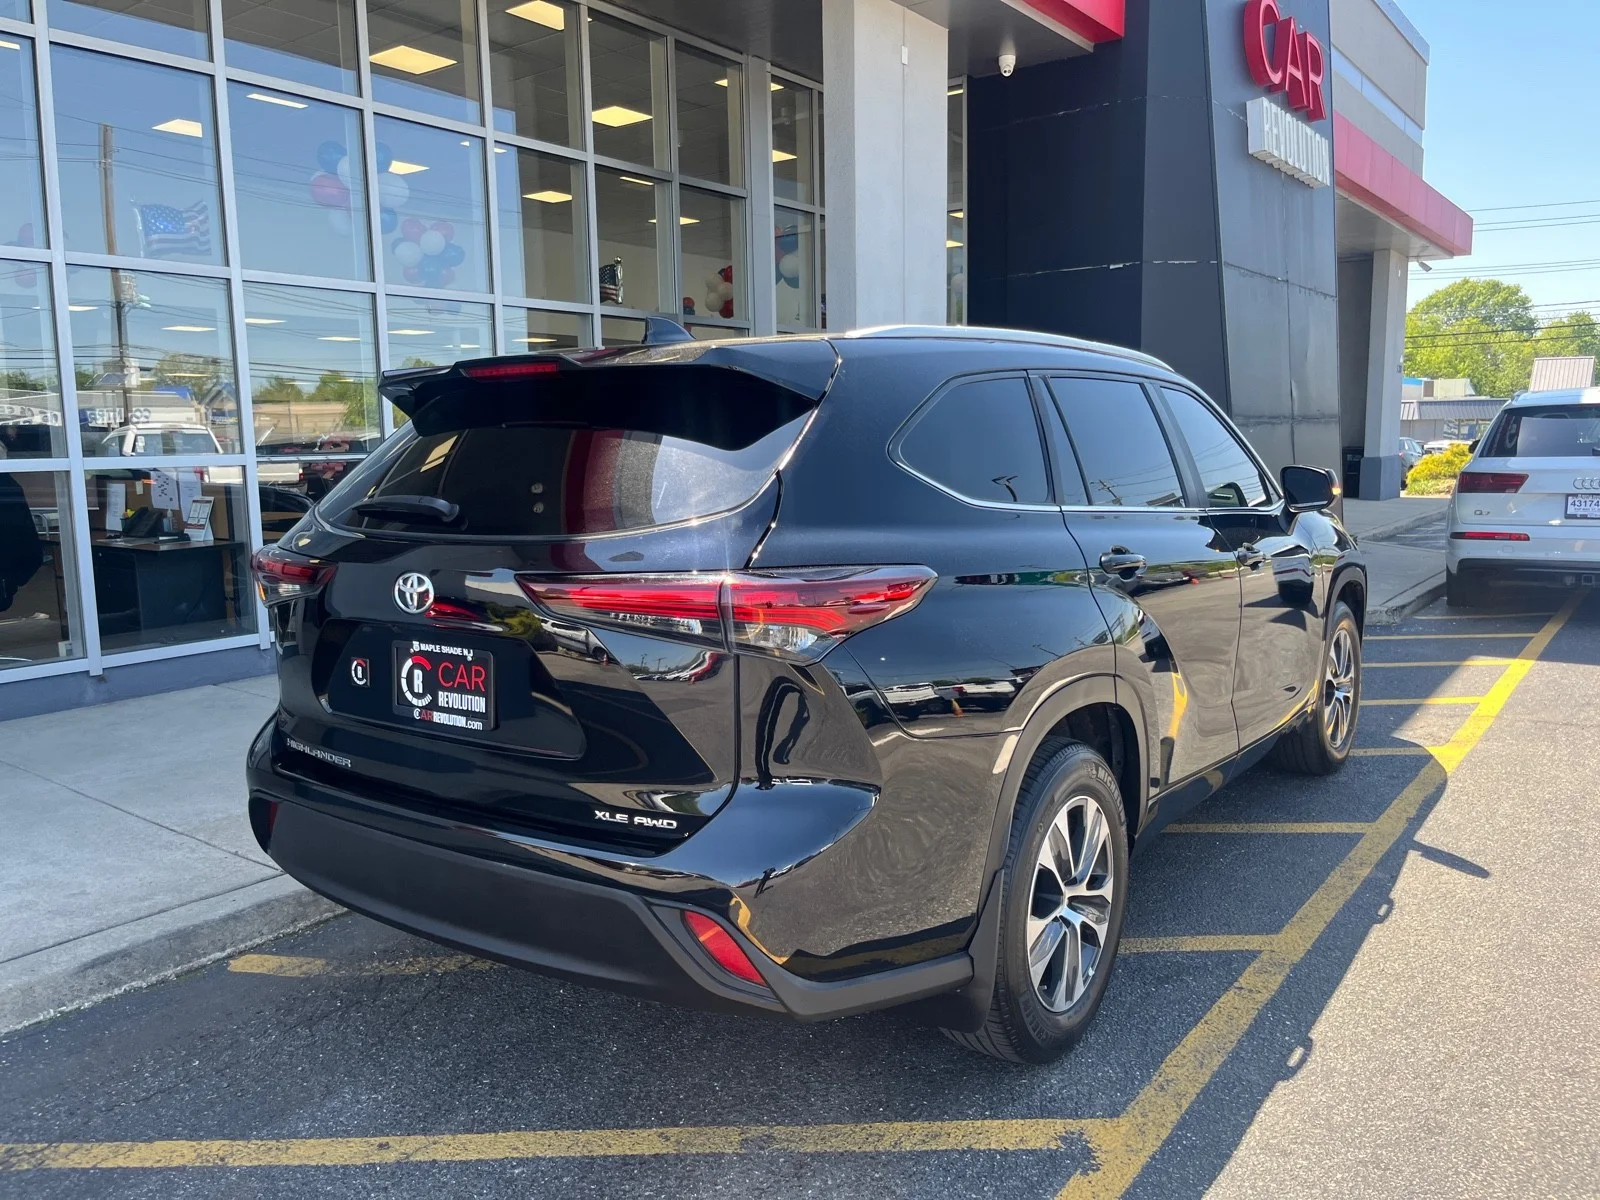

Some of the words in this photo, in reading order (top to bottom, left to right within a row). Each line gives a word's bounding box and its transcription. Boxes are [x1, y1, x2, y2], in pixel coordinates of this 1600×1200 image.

[1248, 0, 1326, 121] CAR
[1256, 97, 1330, 187] REVOLUTION
[420, 643, 441, 653] MAPLE
[441, 645, 462, 656] SHADE
[438, 661, 486, 692] CAR
[438, 691, 486, 713] REVOLUTION
[287, 738, 351, 767] HIGHLANDER
[594, 810, 628, 824] XLE
[633, 816, 677, 830] AWD
